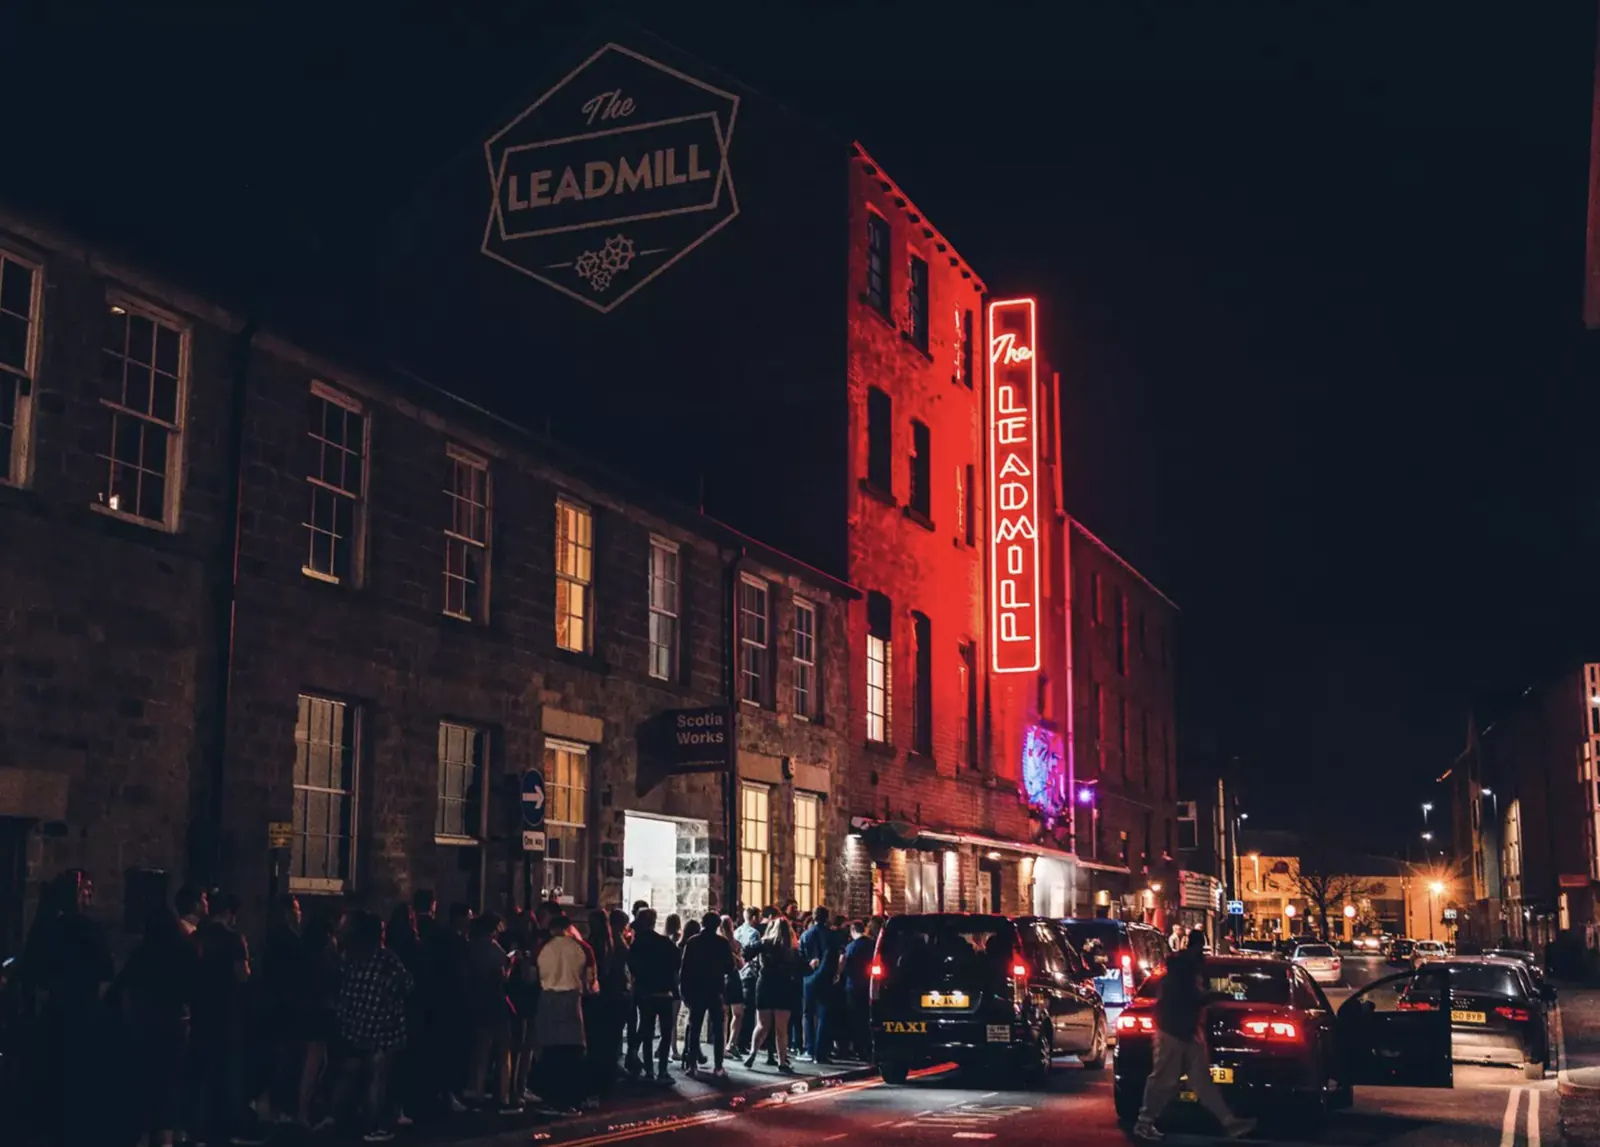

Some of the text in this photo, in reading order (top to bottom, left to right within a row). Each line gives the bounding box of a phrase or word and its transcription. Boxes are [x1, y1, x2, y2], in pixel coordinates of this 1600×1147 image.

[581, 88, 636, 125] The
[507, 144, 711, 212] LEADMILL
[991, 333, 1033, 364] The
[995, 385, 1036, 642] LEADMILL
[676, 712, 724, 728] Scotia
[676, 730, 725, 745] Works
[882, 1020, 928, 1034] TAXI
